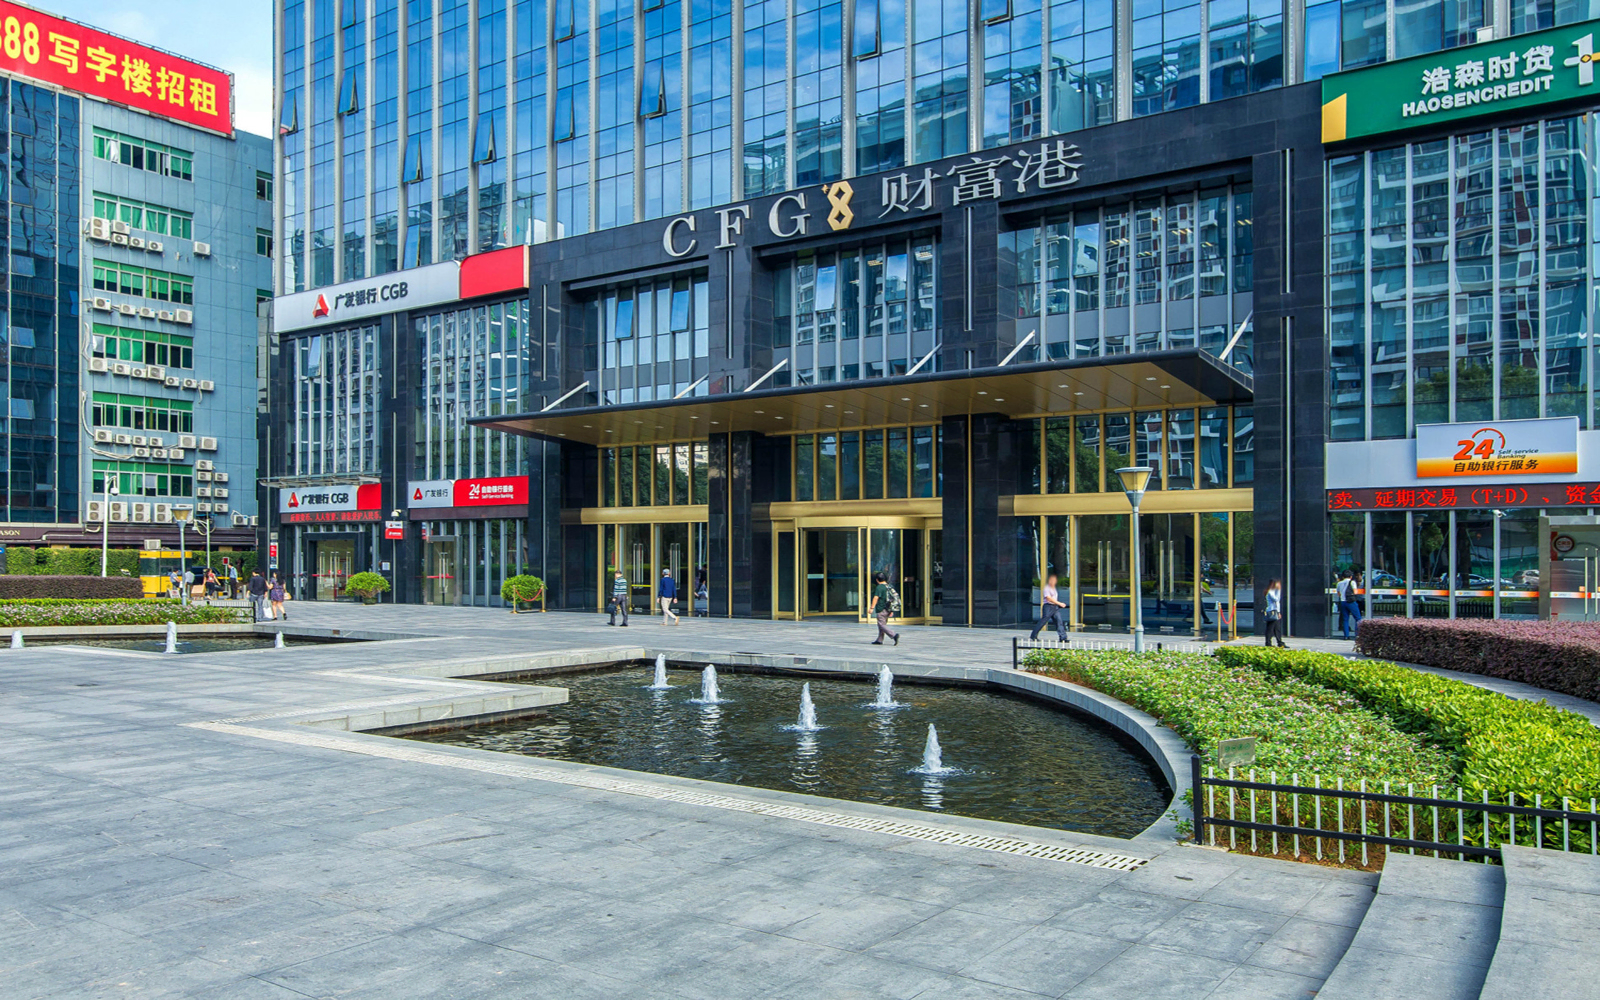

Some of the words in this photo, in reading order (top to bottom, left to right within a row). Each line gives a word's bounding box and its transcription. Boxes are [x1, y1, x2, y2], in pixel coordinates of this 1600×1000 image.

[0, 16, 40, 65] 88
[48, 31, 218, 116] 写字楼招租
[1421, 45, 1554, 95] 浩森时贷
[1402, 75, 1554, 117] HAOSENCREDIT
[878, 140, 1083, 219] 财富港
[334, 287, 377, 310] 广发银行
[380, 281, 408, 301] CGB
[1453, 438, 1494, 460] 24
[1453, 459, 1539, 473] 自助银行服务
[331, 493, 349, 504] CGB
[469, 483, 480, 496] 24
